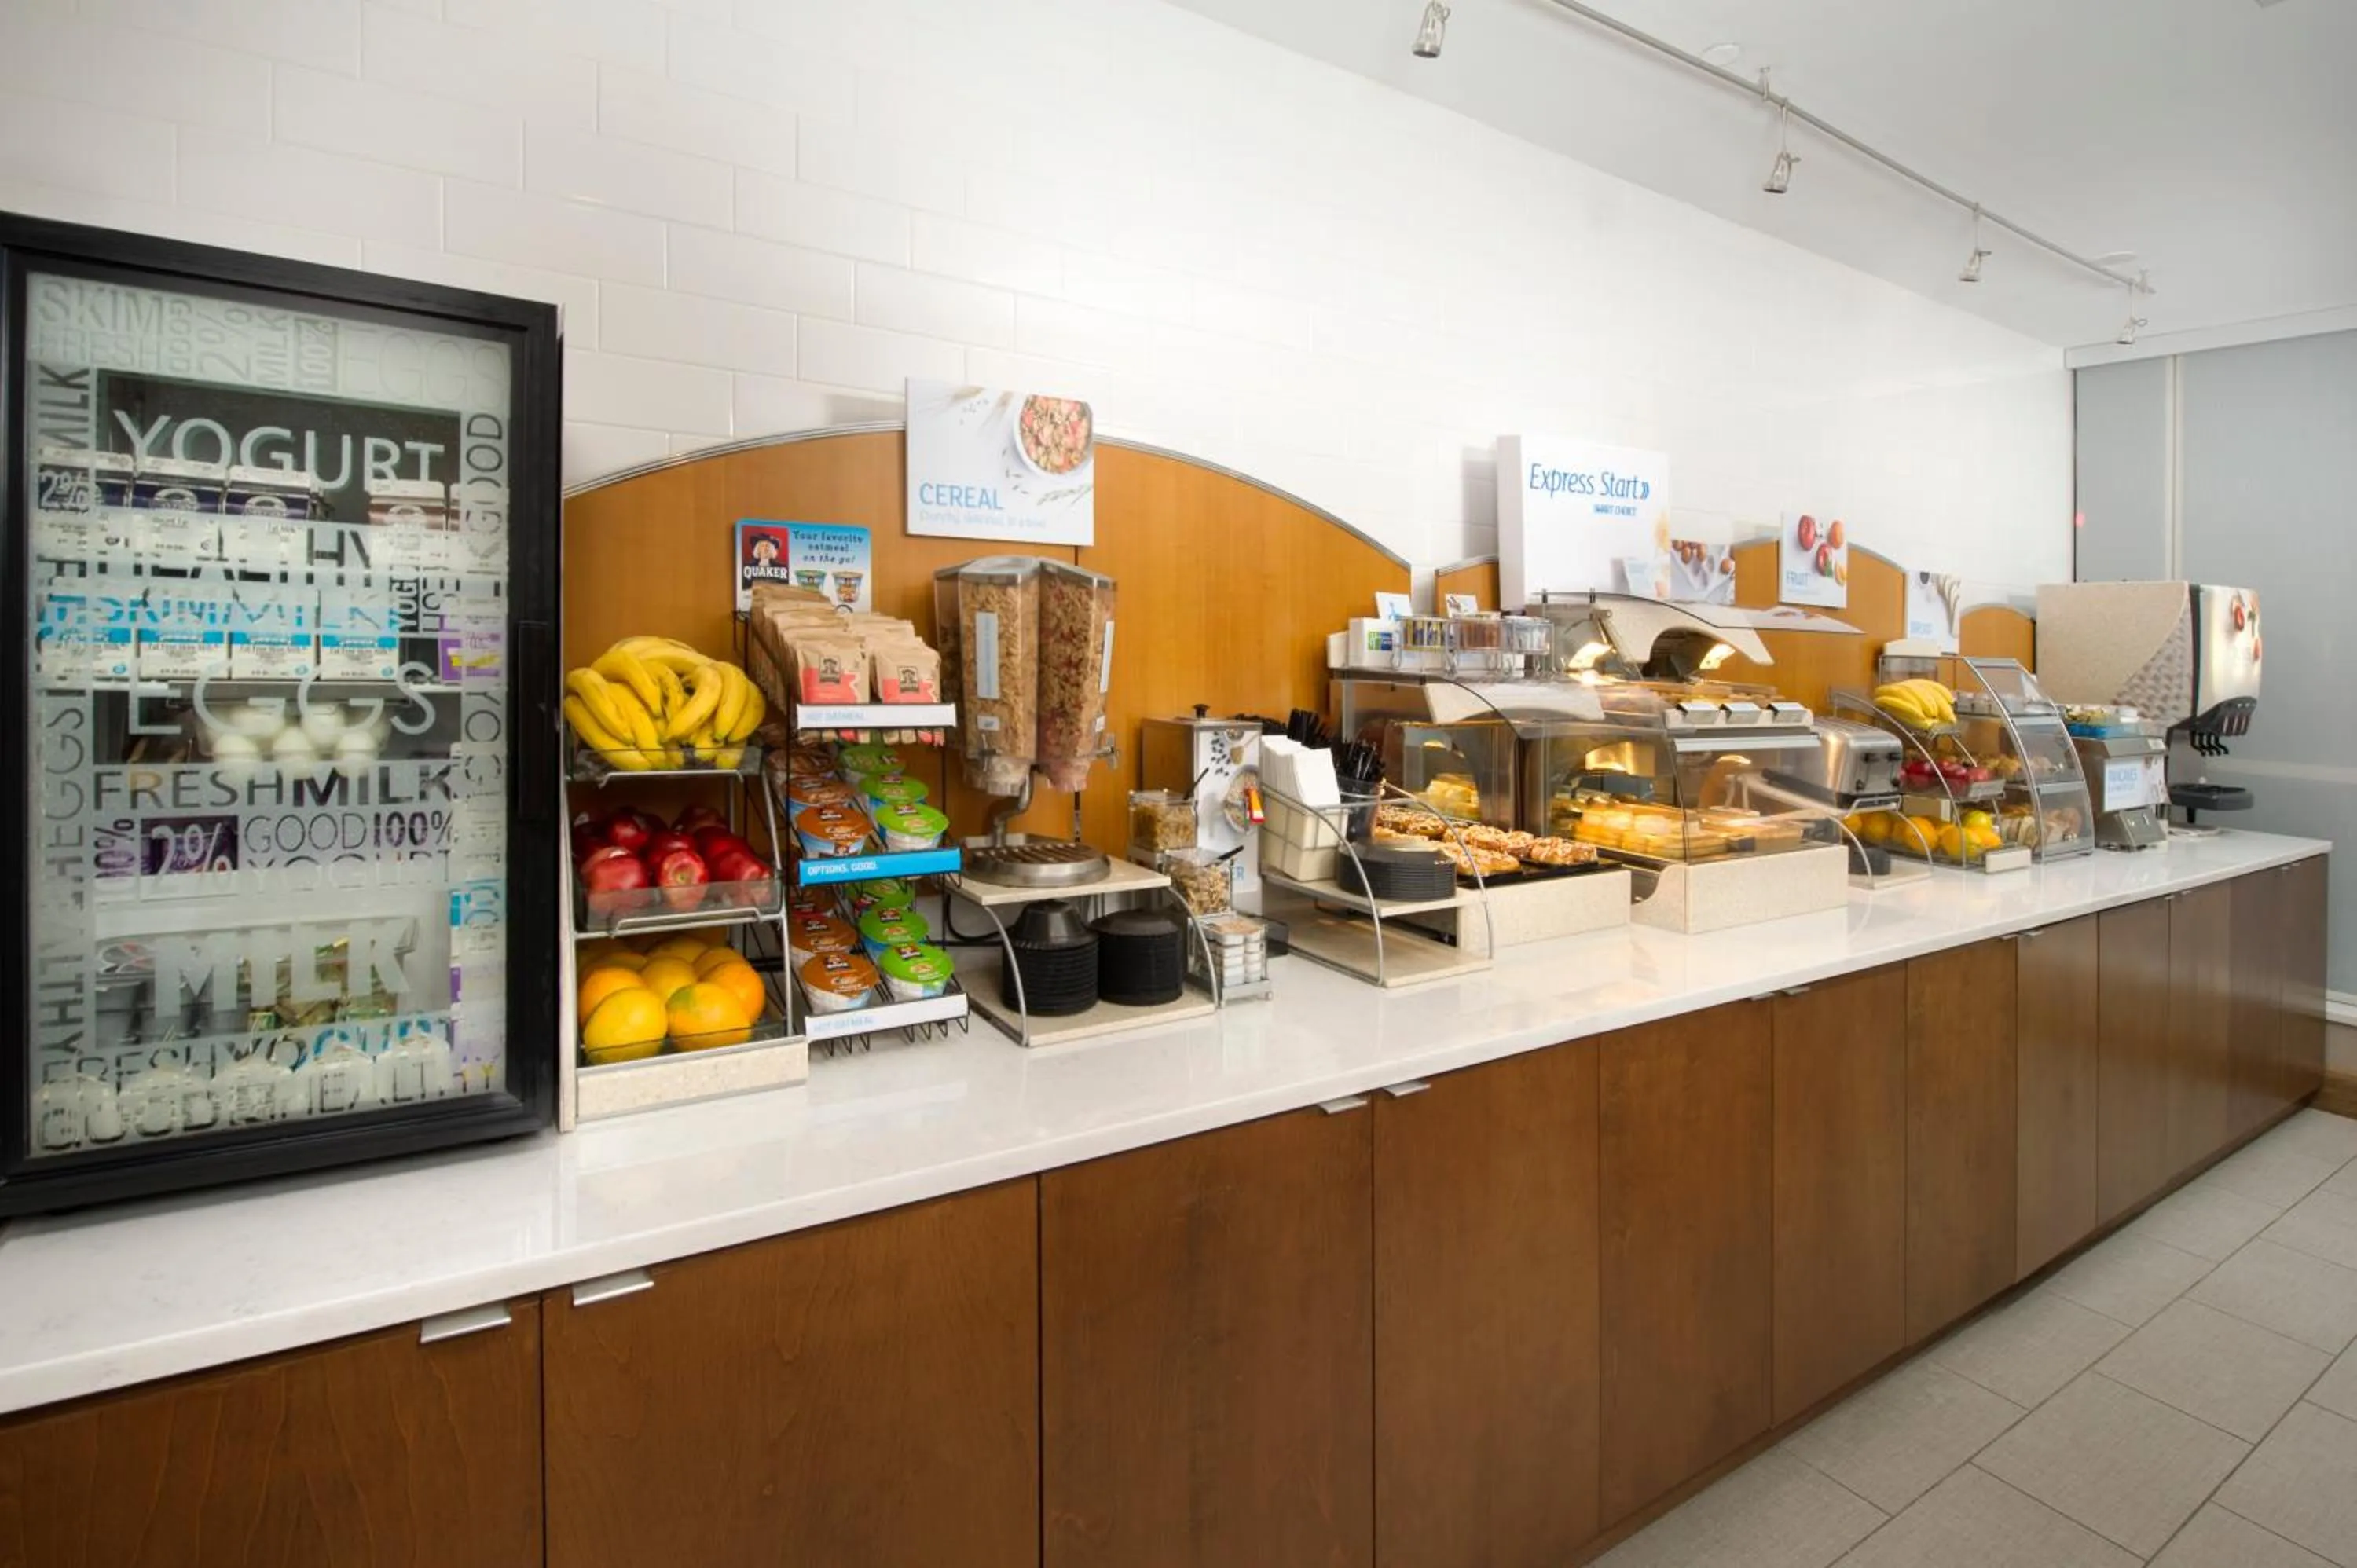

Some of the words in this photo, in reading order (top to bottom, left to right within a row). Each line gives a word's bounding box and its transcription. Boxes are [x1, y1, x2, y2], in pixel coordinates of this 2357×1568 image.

[38, 280, 163, 336] SKIM
[197, 307, 253, 382] 2%
[255, 313, 288, 387] MILK
[300, 321, 333, 388] 100%
[38, 363, 90, 451] MILK
[114, 410, 446, 490] YOGURT
[1530, 463, 1595, 499] Express
[1600, 471, 1639, 500] Start
[919, 482, 1004, 511] CEREAL
[794, 530, 817, 540] Your
[821, 532, 863, 544] favorite
[743, 566, 788, 580] QUAKER
[128, 661, 436, 735] EGGS
[45, 707, 85, 847] EGGS
[93, 767, 284, 811] FRESH
[292, 765, 452, 808] MILK
[151, 822, 233, 897] 2%
[244, 812, 367, 853] GOOD
[372, 810, 454, 848] 100%
[155, 916, 423, 1020] MILK
